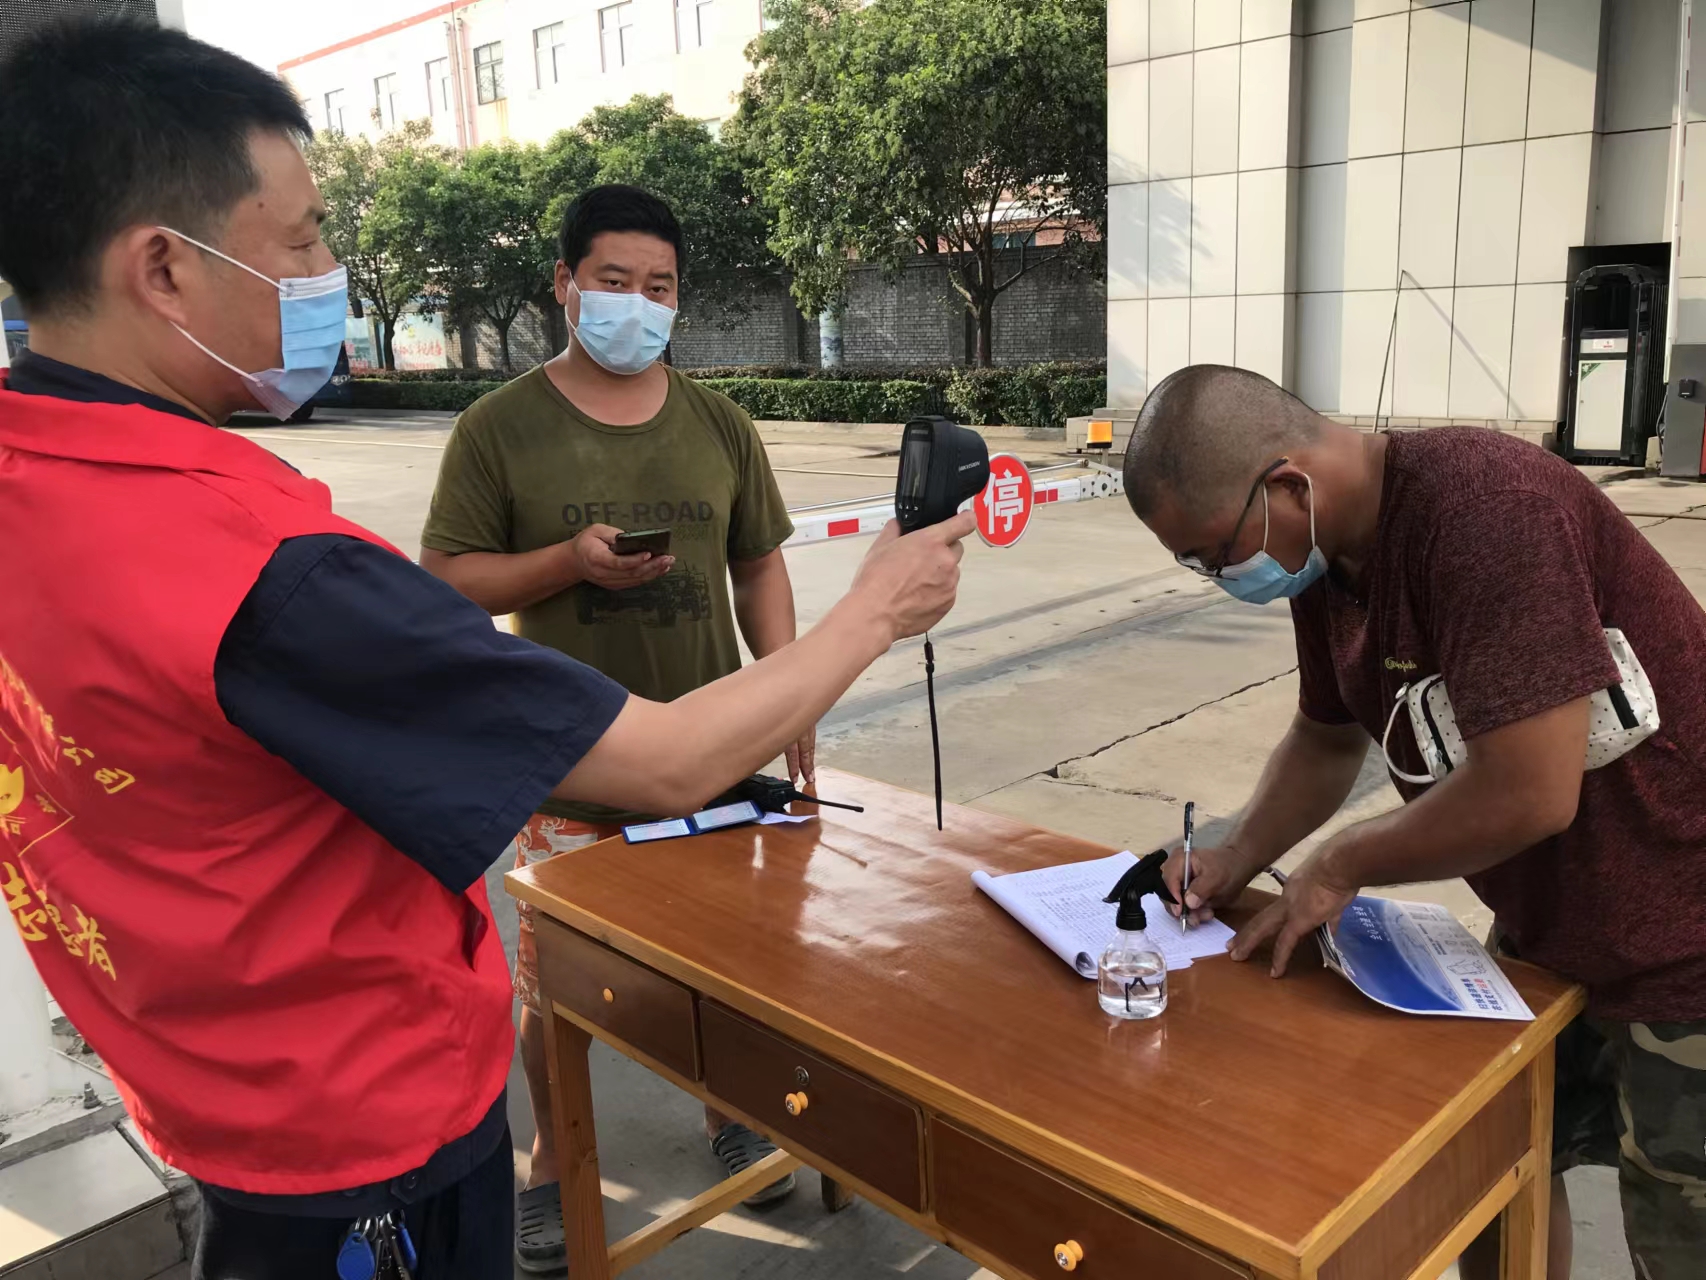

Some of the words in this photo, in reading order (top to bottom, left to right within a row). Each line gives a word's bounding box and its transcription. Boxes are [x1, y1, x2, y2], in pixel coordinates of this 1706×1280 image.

[561, 500, 714, 526] OFF-ROAD
[983, 469, 1024, 535] 停
[1, 861, 117, 981] 志愿者
